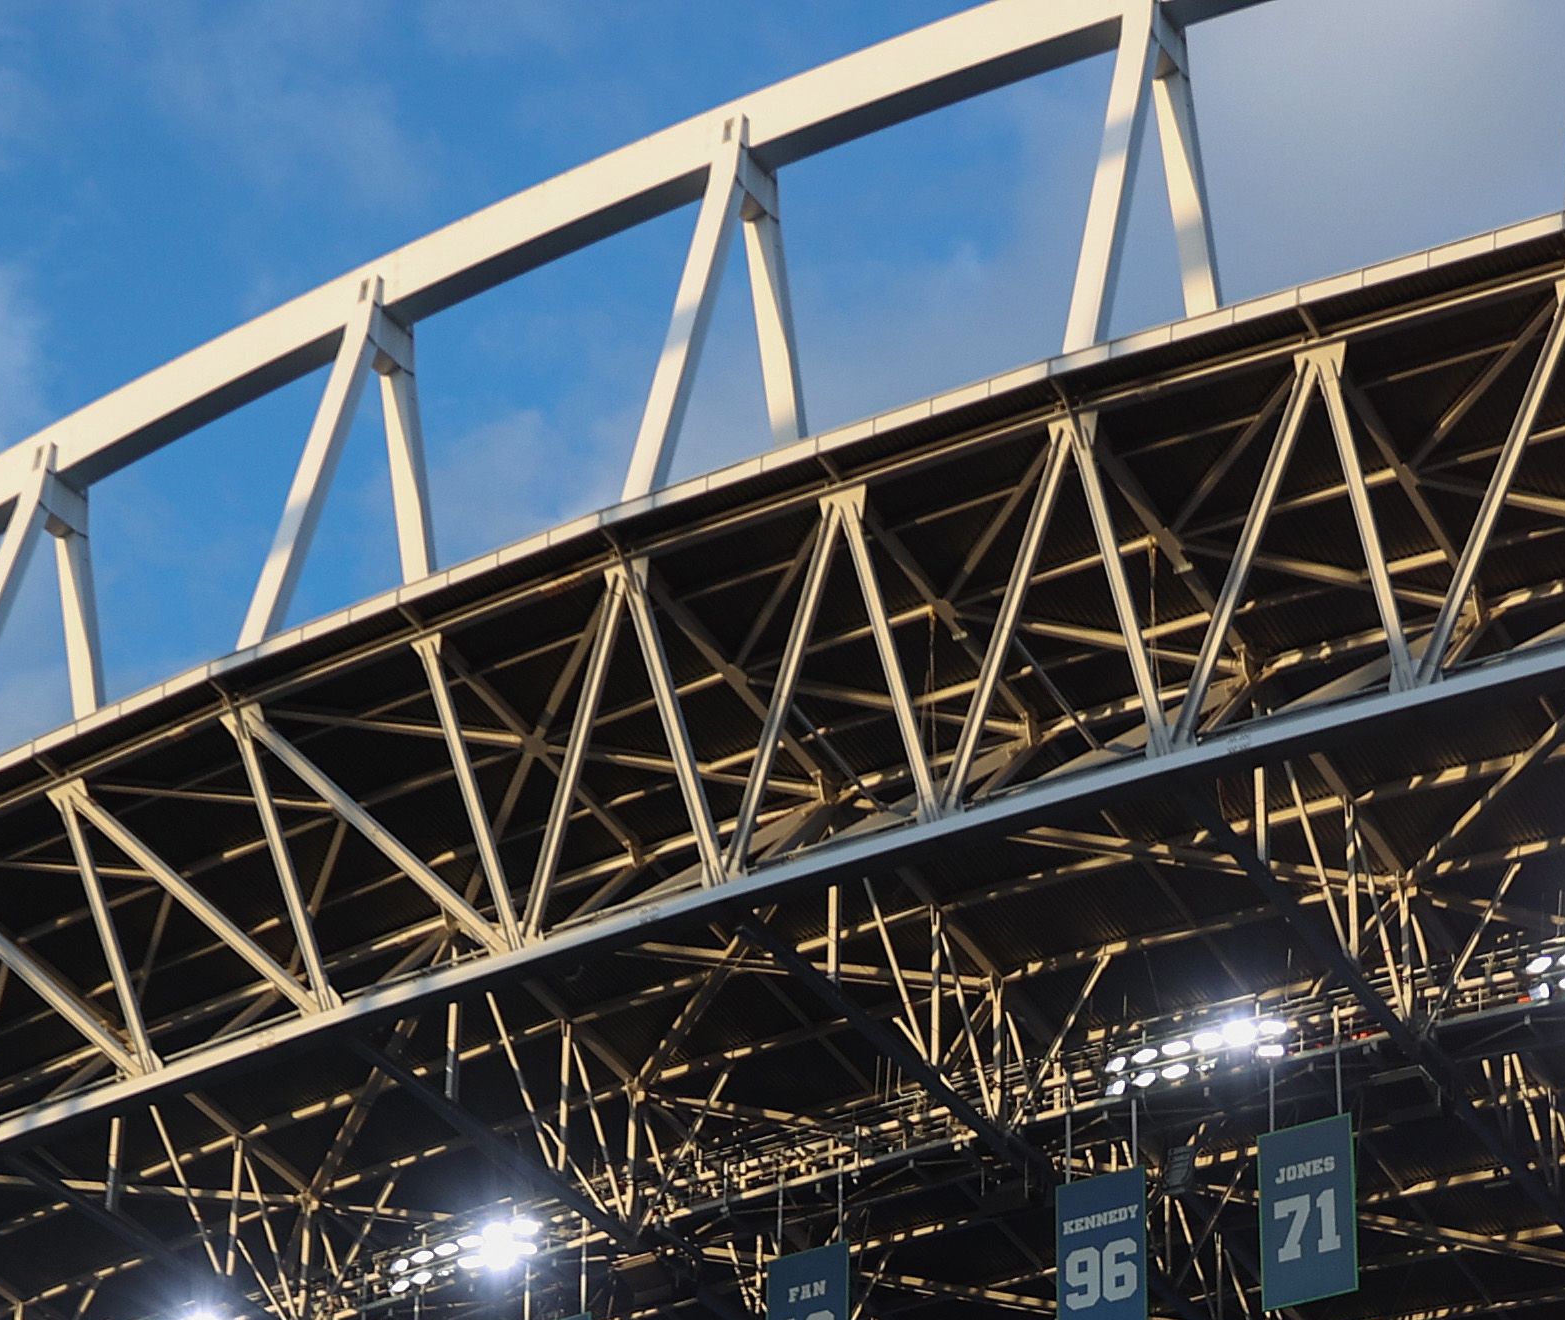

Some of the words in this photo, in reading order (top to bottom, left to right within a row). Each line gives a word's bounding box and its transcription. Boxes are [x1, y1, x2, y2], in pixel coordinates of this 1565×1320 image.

[1275, 1156, 1335, 1185] JONES
[1062, 1204, 1139, 1236] KENNEDY
[1273, 1188, 1341, 1263] 71
[1065, 1237, 1137, 1311] 96
[788, 1280, 826, 1302] FAN
